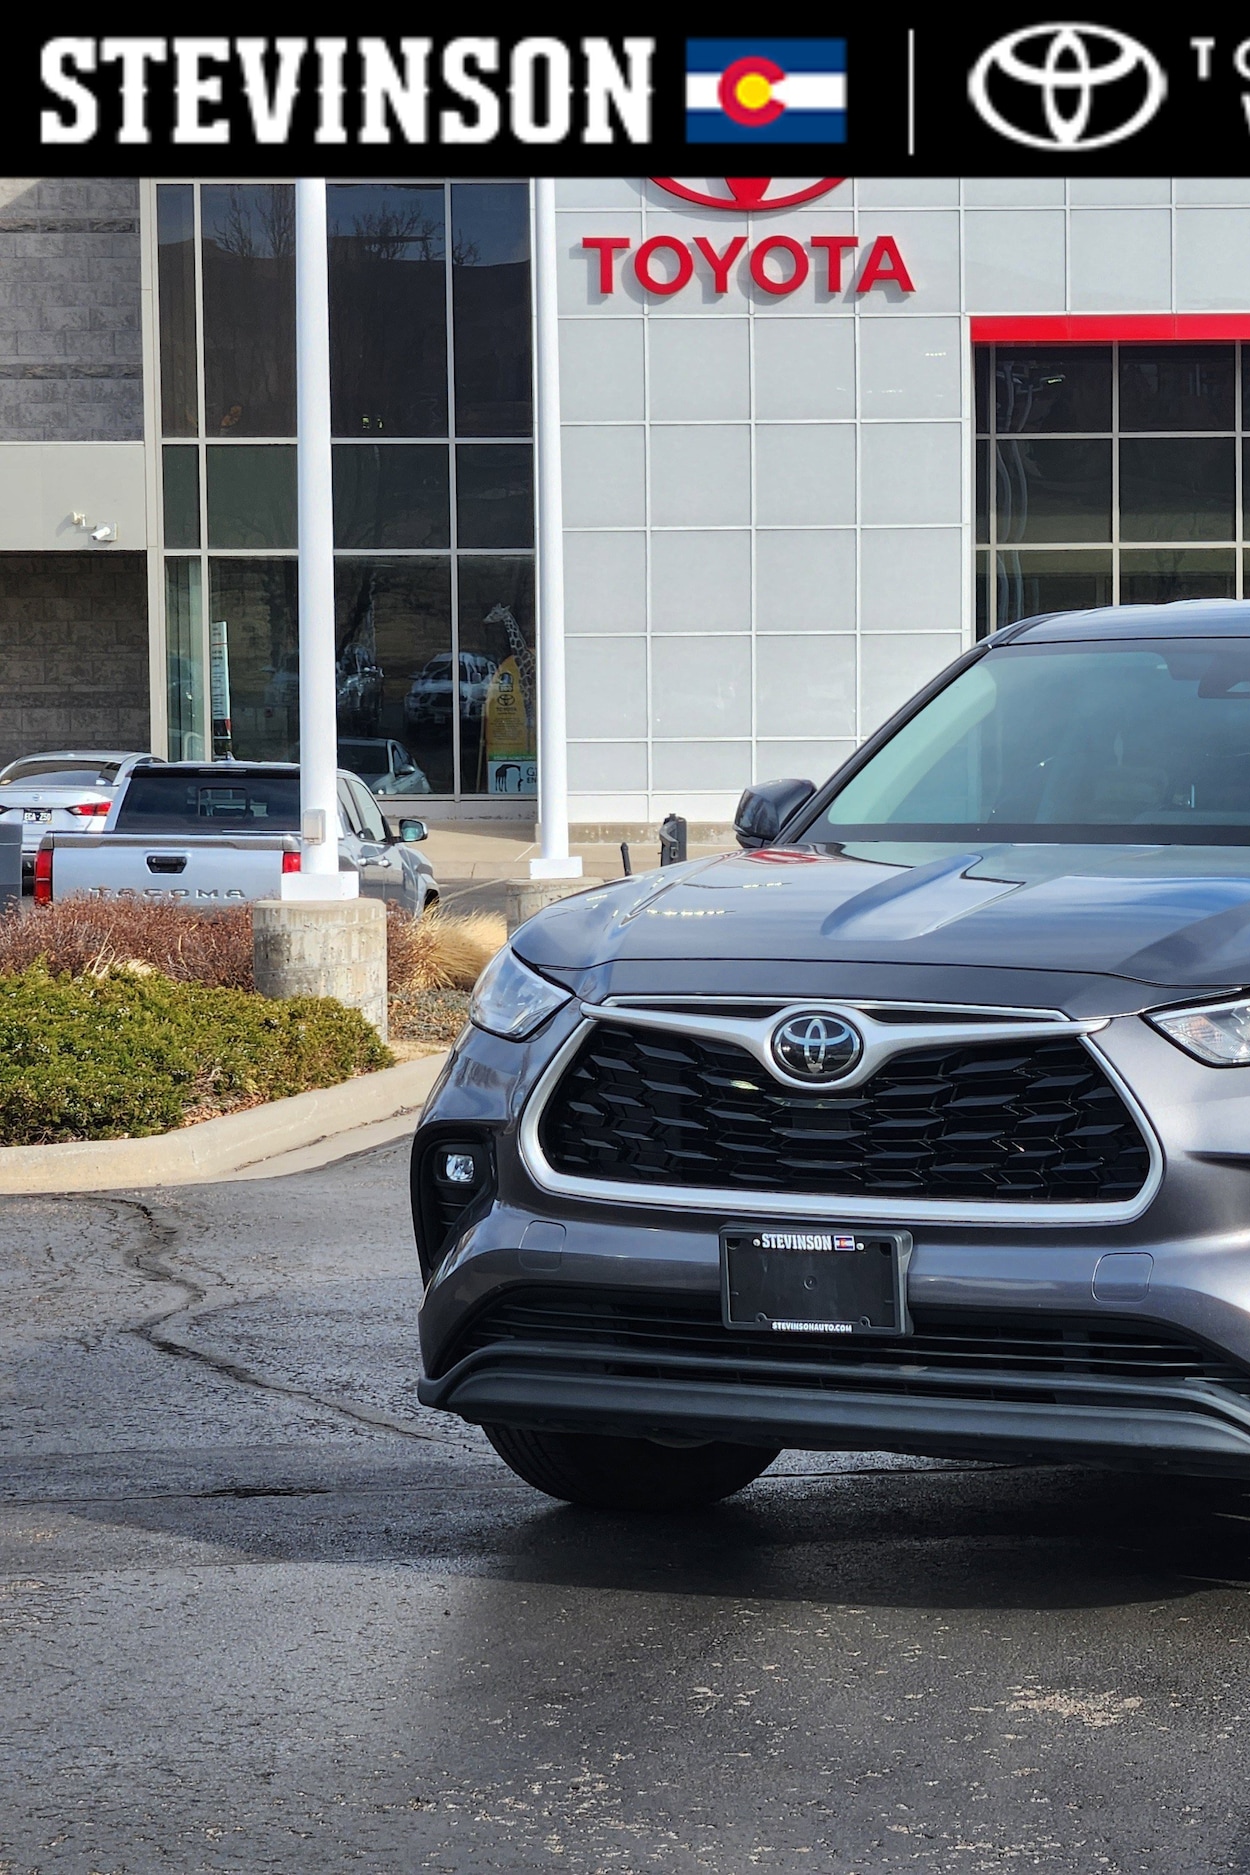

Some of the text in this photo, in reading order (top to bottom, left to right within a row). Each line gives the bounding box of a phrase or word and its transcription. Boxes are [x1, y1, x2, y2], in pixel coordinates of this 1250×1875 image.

[582, 235, 916, 295] TOYOTA
[89, 887, 246, 899] TACOMA
[762, 1233, 832, 1251] STEVINSON
[772, 1322, 852, 1333] STEVINSONAUTO.COM
